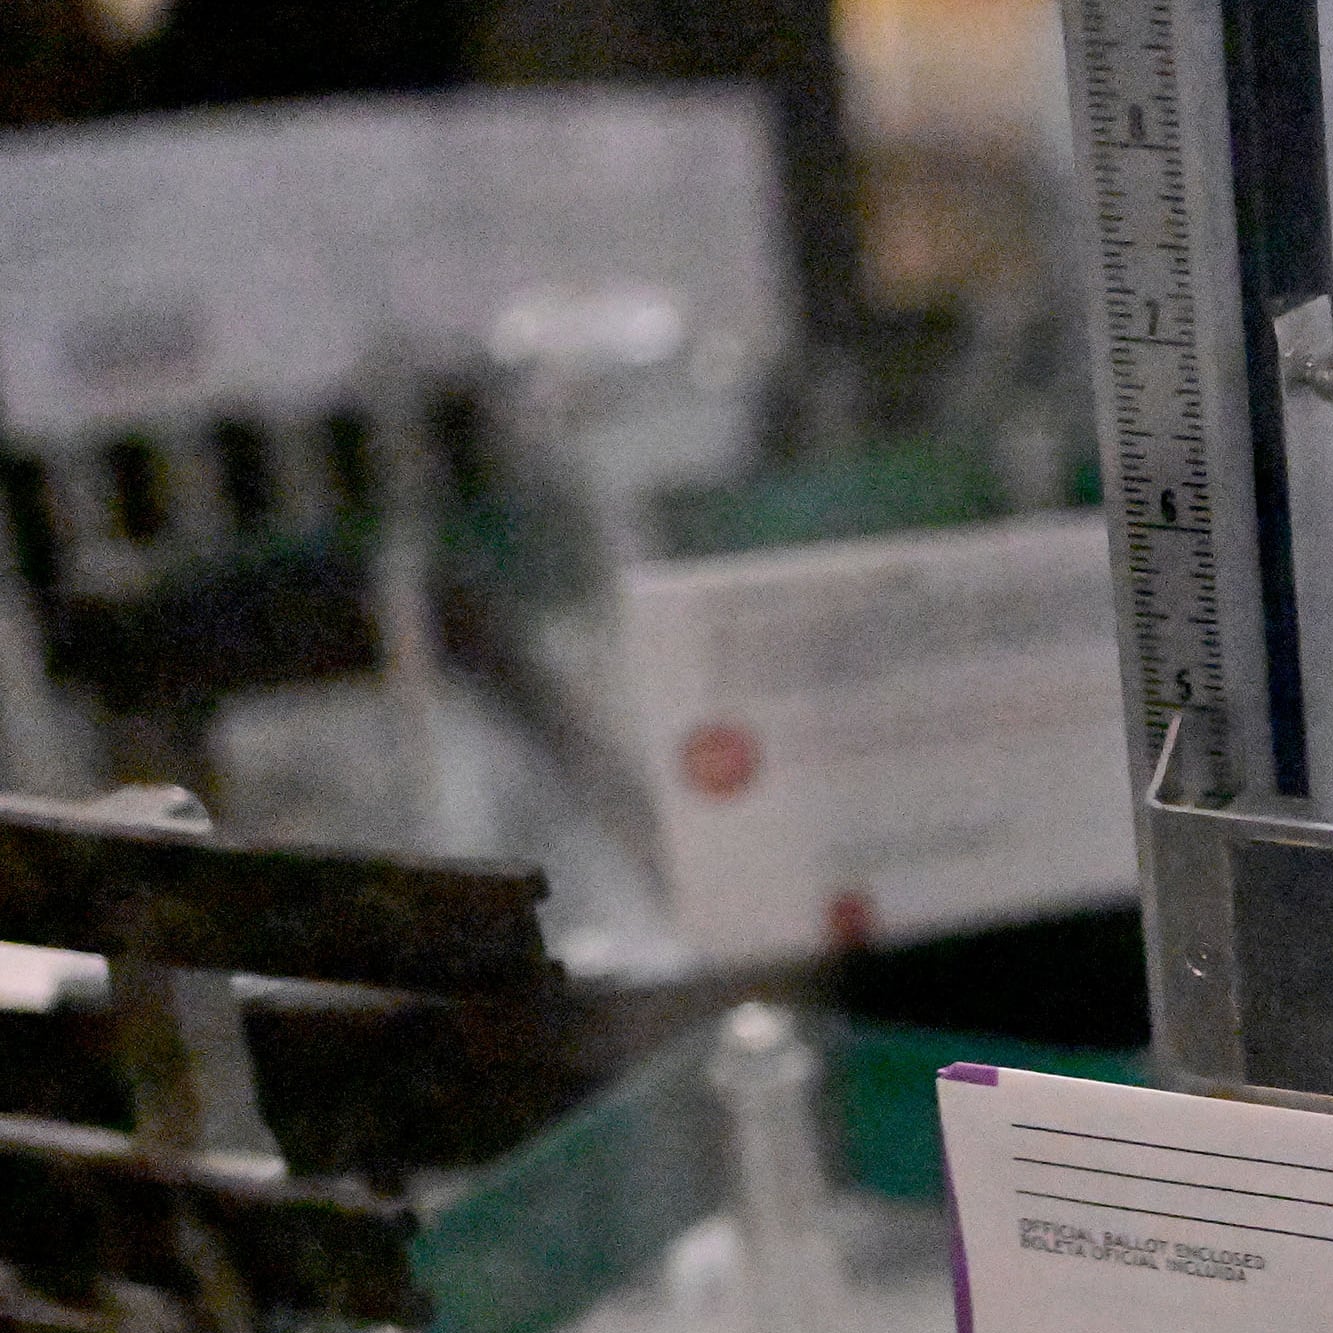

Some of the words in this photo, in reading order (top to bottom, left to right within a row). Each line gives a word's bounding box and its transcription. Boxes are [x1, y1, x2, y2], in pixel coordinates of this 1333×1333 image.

[1145, 298, 1161, 336] 7
[1159, 487, 1178, 524] 6
[1175, 667, 1193, 702] 5
[1019, 1217, 1095, 1245] OFFICIAL
[1103, 1231, 1168, 1254] BALLOT
[1173, 1243, 1266, 1271] ENCLOSED
[1019, 1233, 1087, 1258] BOLETA
[1091, 1245, 1160, 1271] OFICIAL
[1166, 1258, 1248, 1284] INCLUIDA
